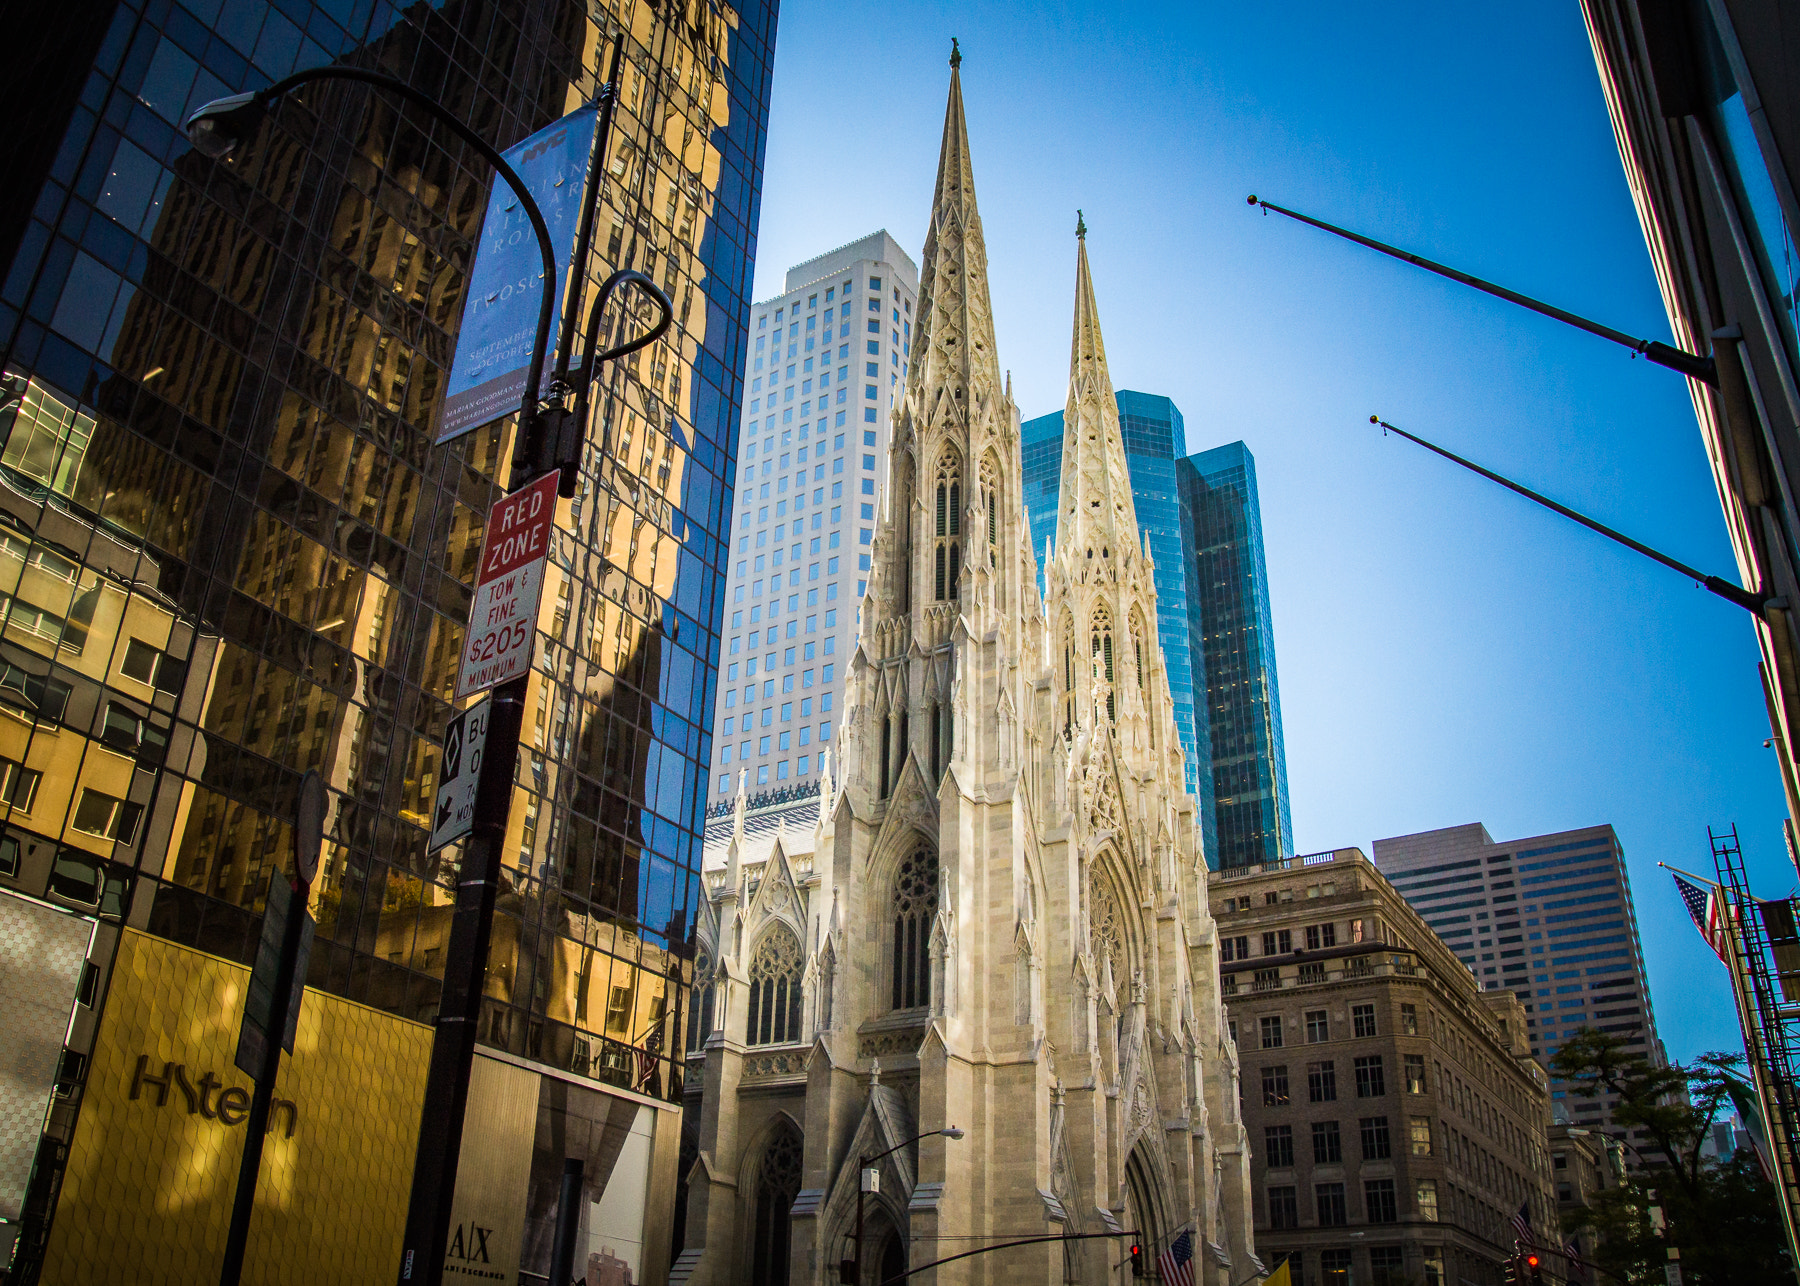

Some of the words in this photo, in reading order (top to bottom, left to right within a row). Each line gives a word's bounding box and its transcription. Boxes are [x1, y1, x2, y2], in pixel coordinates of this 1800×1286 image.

[521, 128, 568, 165] NYC
[487, 181, 580, 237] VILAR
[492, 207, 563, 255] ROJS
[469, 326, 537, 361] SEPTEMBER
[479, 340, 533, 369] OCTOBER
[501, 491, 543, 533] RED
[487, 522, 544, 573] ZONE
[489, 575, 517, 604] TOW
[487, 597, 519, 628] FINE
[469, 618, 528, 665] $205
[467, 656, 517, 688] MINIMUM
[461, 1266, 506, 1280] EXCHANGE
